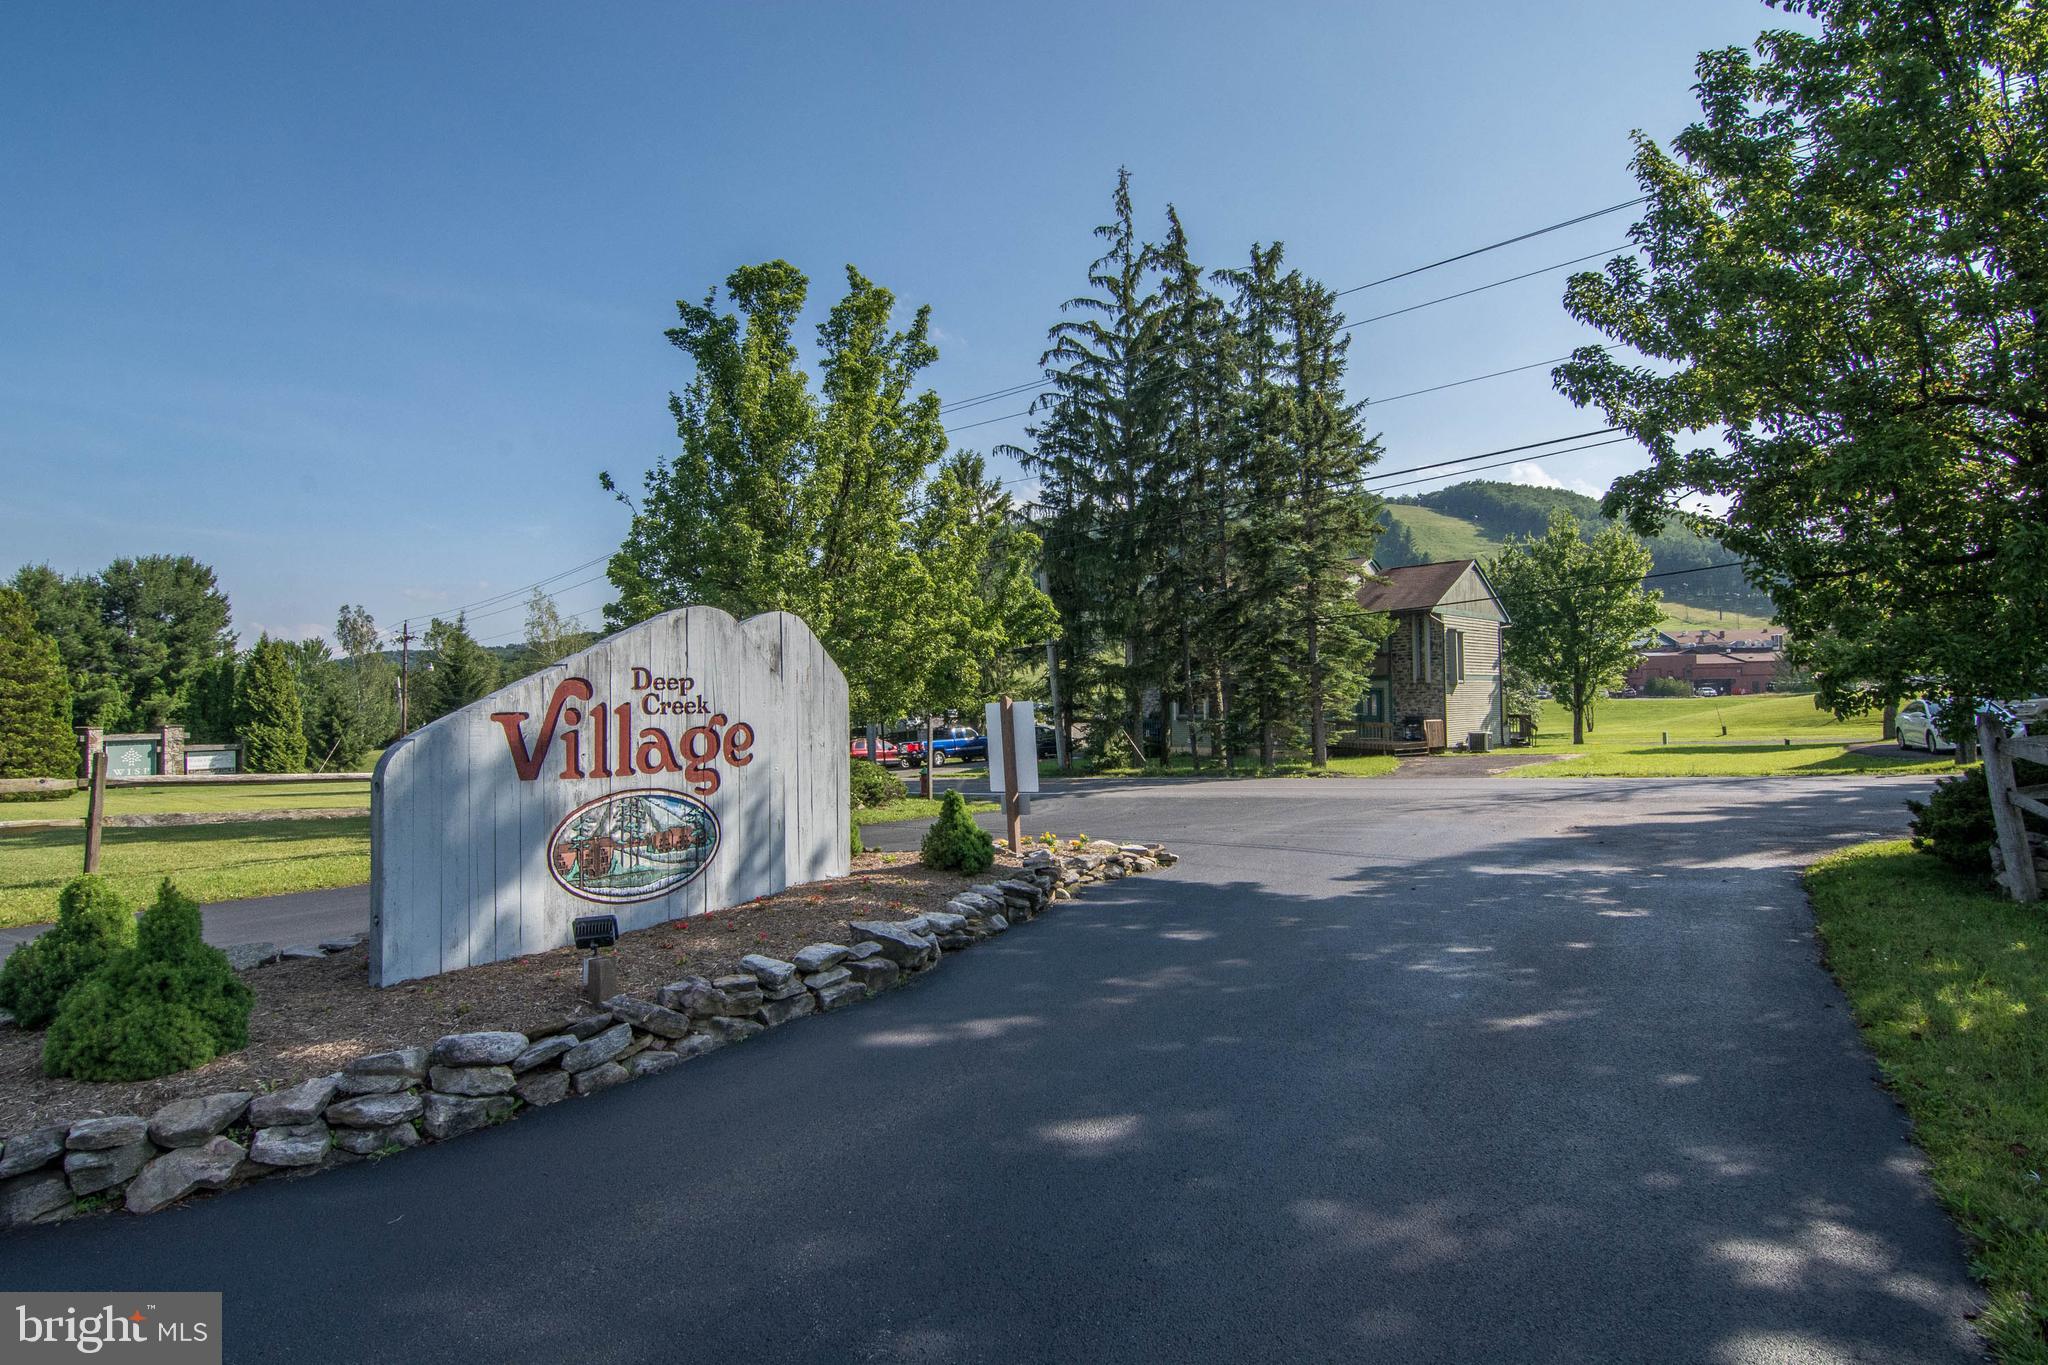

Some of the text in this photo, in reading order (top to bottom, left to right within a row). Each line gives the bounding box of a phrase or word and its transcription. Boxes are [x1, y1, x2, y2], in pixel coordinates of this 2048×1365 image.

[631, 666, 695, 697] Deep
[641, 693, 711, 716] Creek
[490, 677, 756, 796] Village
